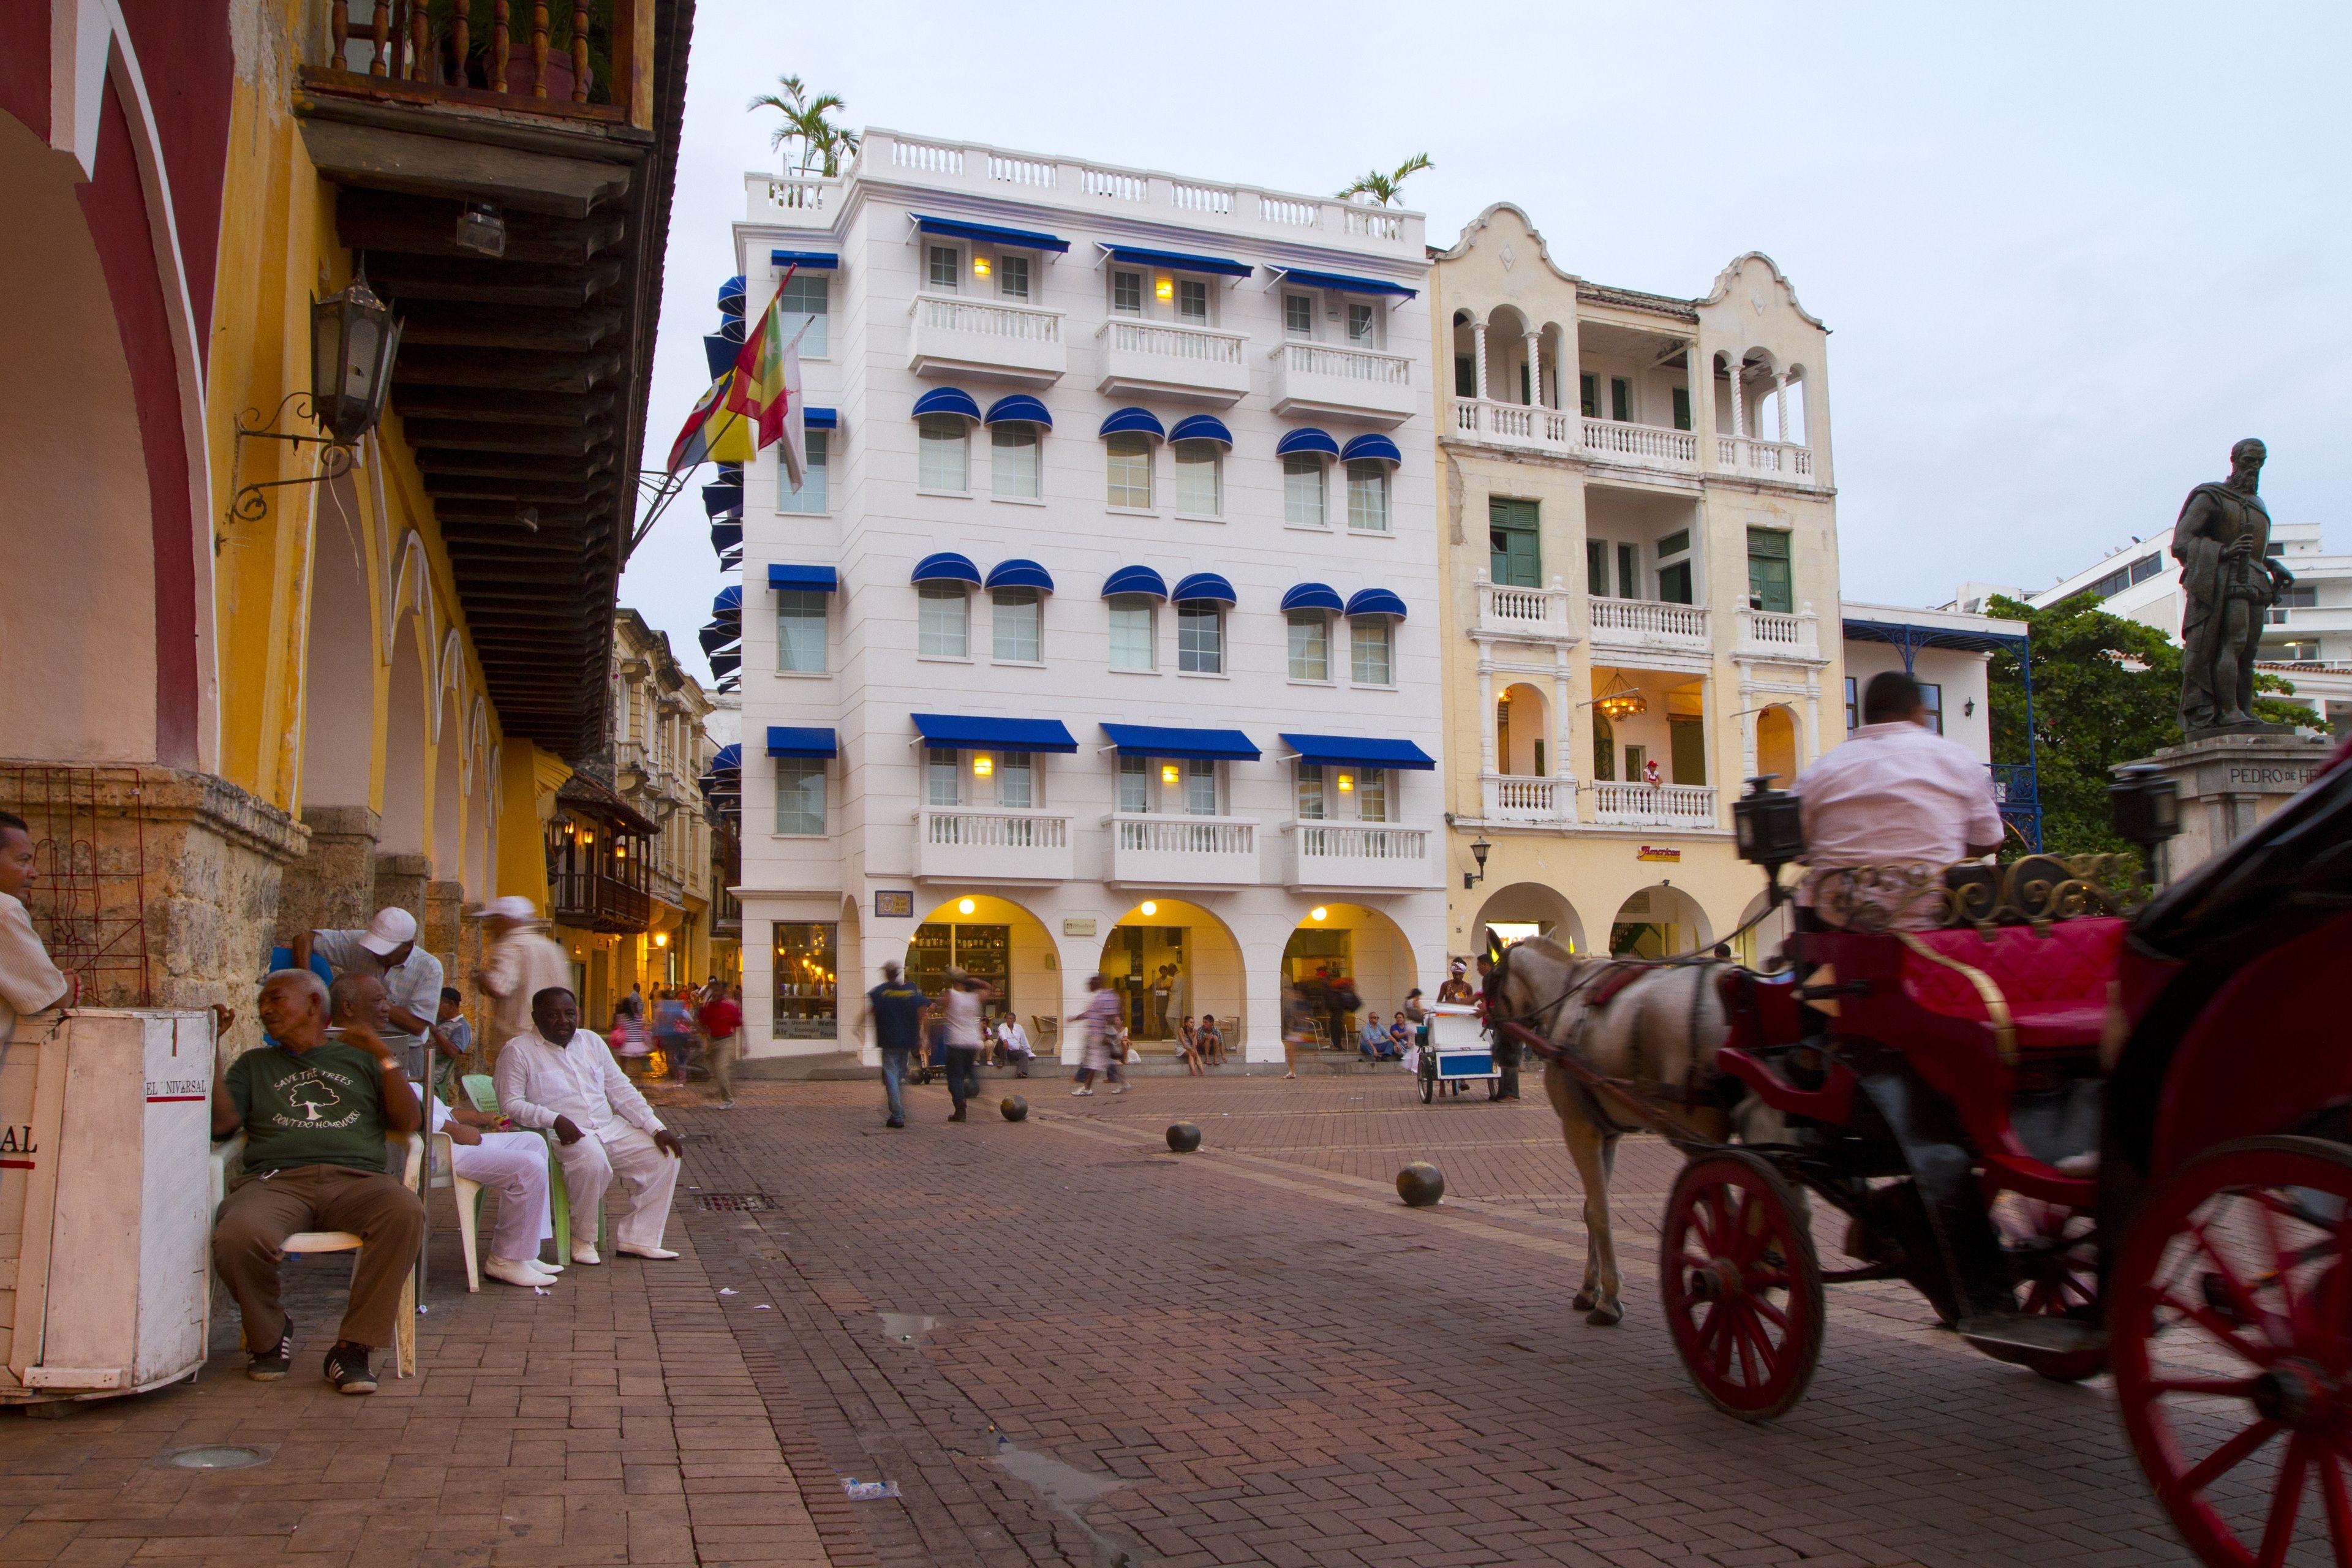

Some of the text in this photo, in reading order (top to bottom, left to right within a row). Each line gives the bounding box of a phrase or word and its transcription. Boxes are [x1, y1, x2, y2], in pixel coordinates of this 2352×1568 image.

[2231, 769, 2283, 783] PEDRO
[2285, 772, 2296, 780] DE
[1637, 846, 1681, 859] American
[274, 1068, 353, 1090] SAVE THE TREES
[146, 1080, 206, 1095] EL NIVERSAL
[315, 1109, 361, 1129] HOMEWORK!
